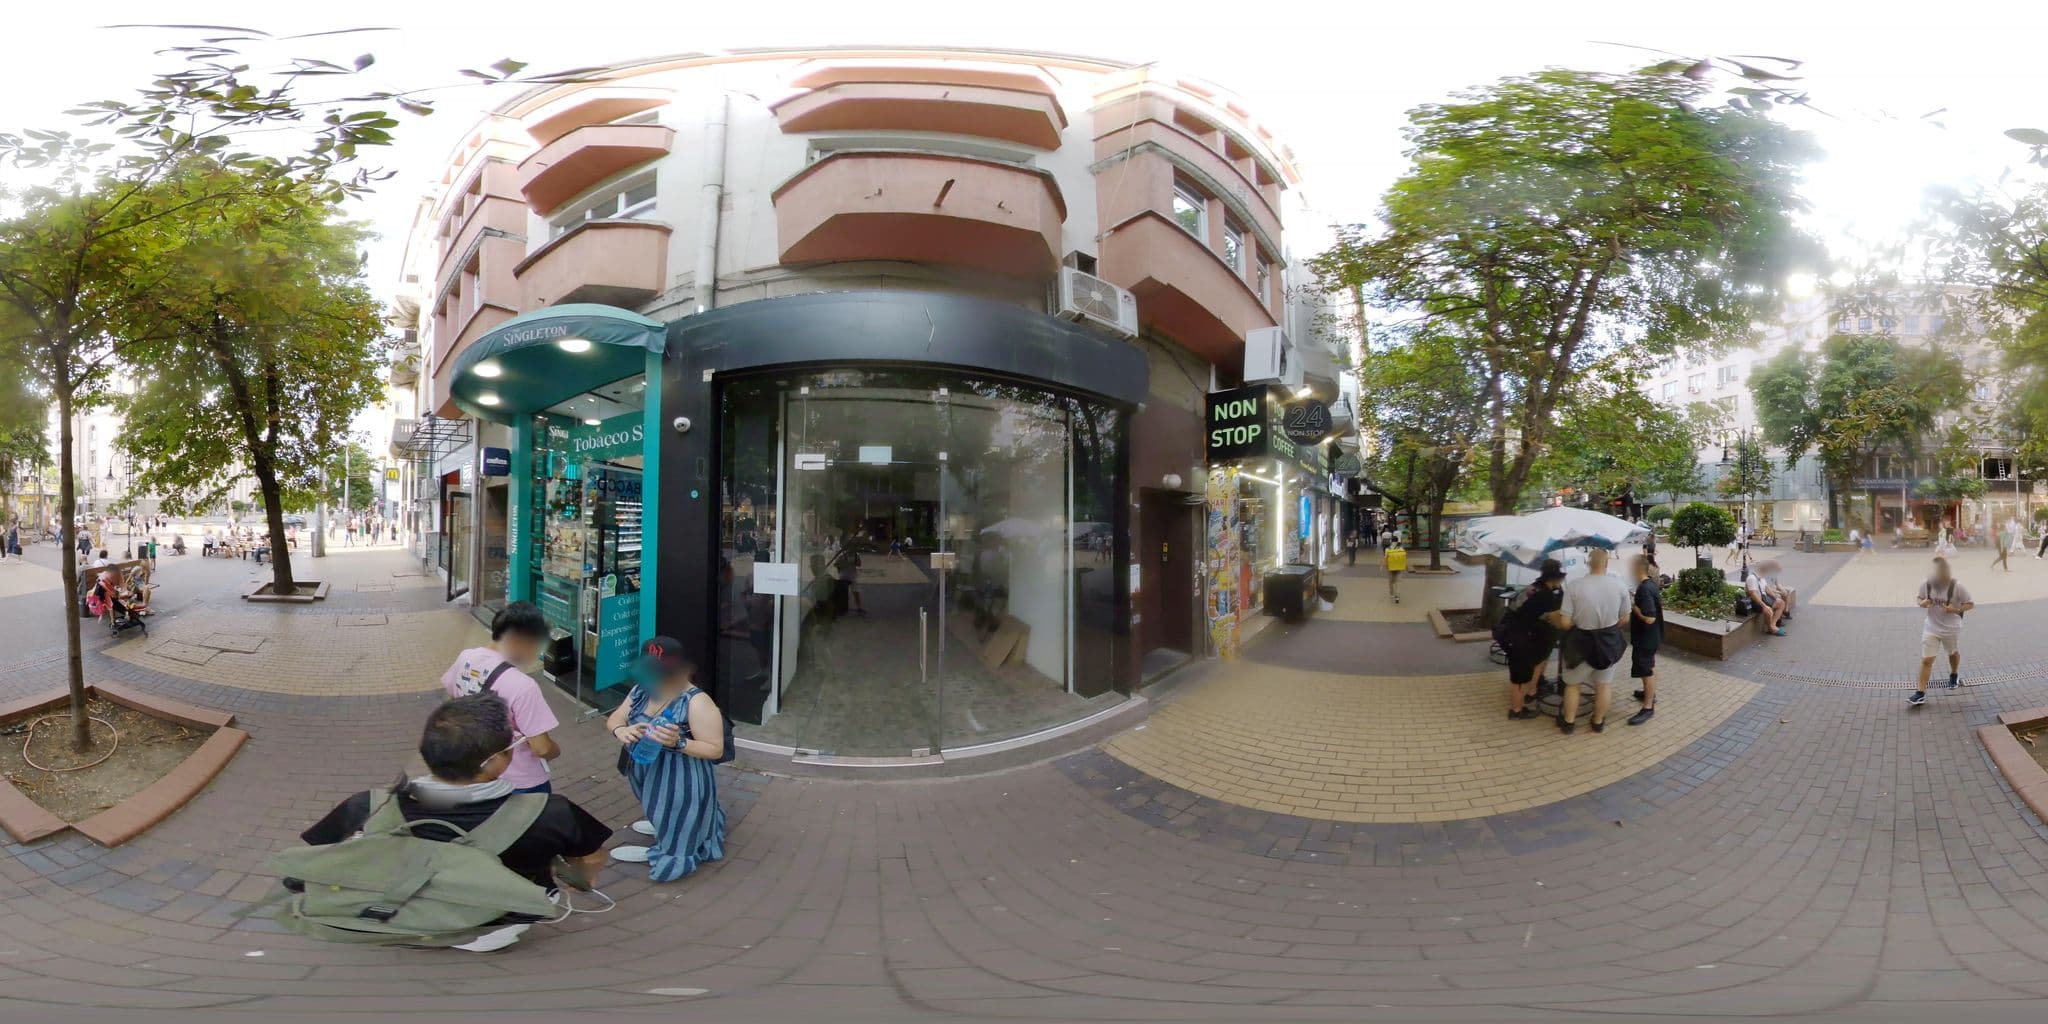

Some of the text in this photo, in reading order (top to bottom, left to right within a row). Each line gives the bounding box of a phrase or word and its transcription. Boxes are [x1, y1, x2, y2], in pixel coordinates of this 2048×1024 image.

[503, 325, 567, 346] SINGLETON
[1215, 398, 1256, 421] NON
[1290, 405, 1323, 428] 24
[573, 431, 629, 452] Tobacco
[1211, 424, 1261, 447] STOP
[1273, 434, 1294, 458] COFFEE
[613, 609, 631, 621] Cold
